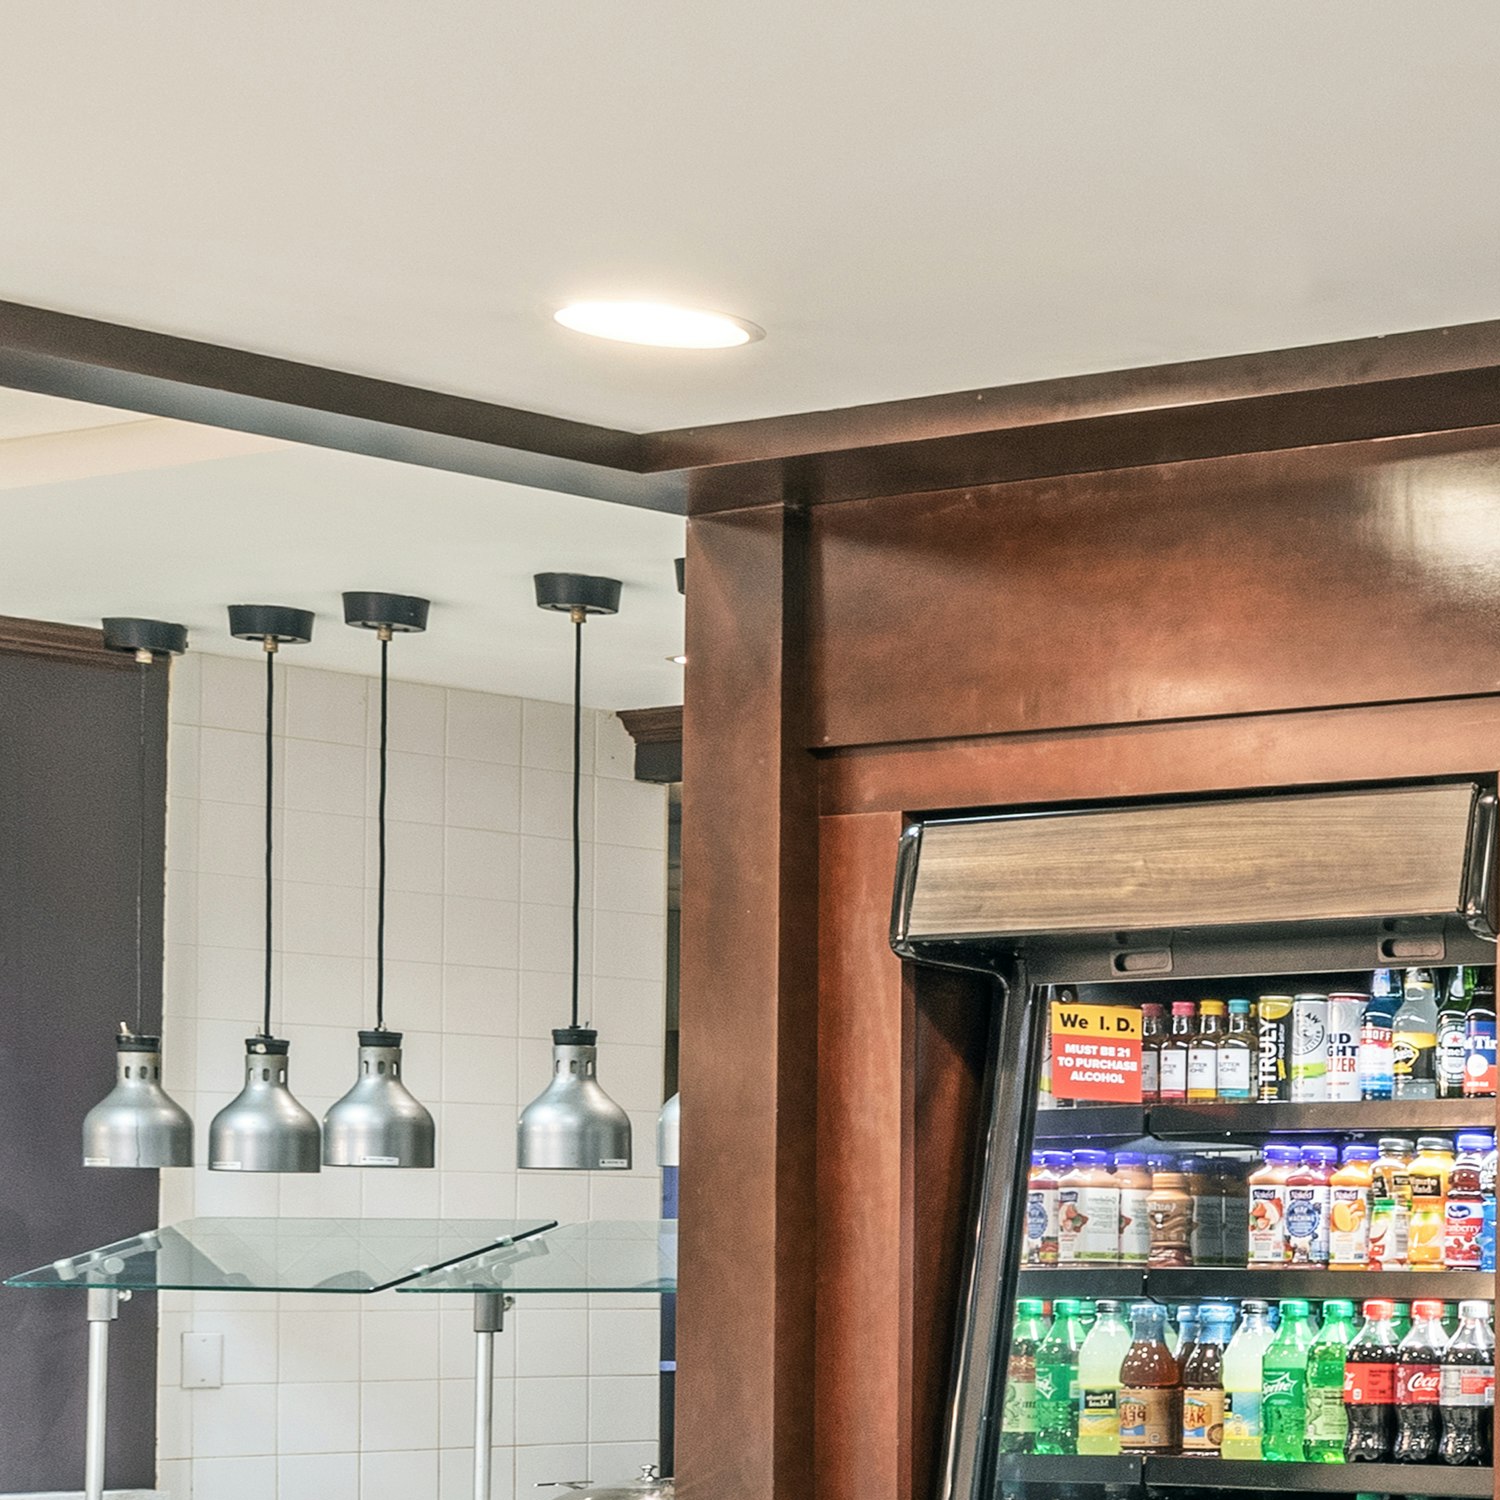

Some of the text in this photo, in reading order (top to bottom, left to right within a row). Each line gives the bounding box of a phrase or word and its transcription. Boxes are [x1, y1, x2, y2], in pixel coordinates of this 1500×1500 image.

[1060, 1013, 1088, 1030] We
[1117, 1018, 1135, 1032] D.
[1065, 1043, 1131, 1058] MUST BE 21
[1259, 1018, 1278, 1085] TRULY
[1057, 1057, 1138, 1072] TO PURCHASE
[1070, 1070, 1125, 1084] ALCOHOL
[1408, 1371, 1440, 1391] Coca
